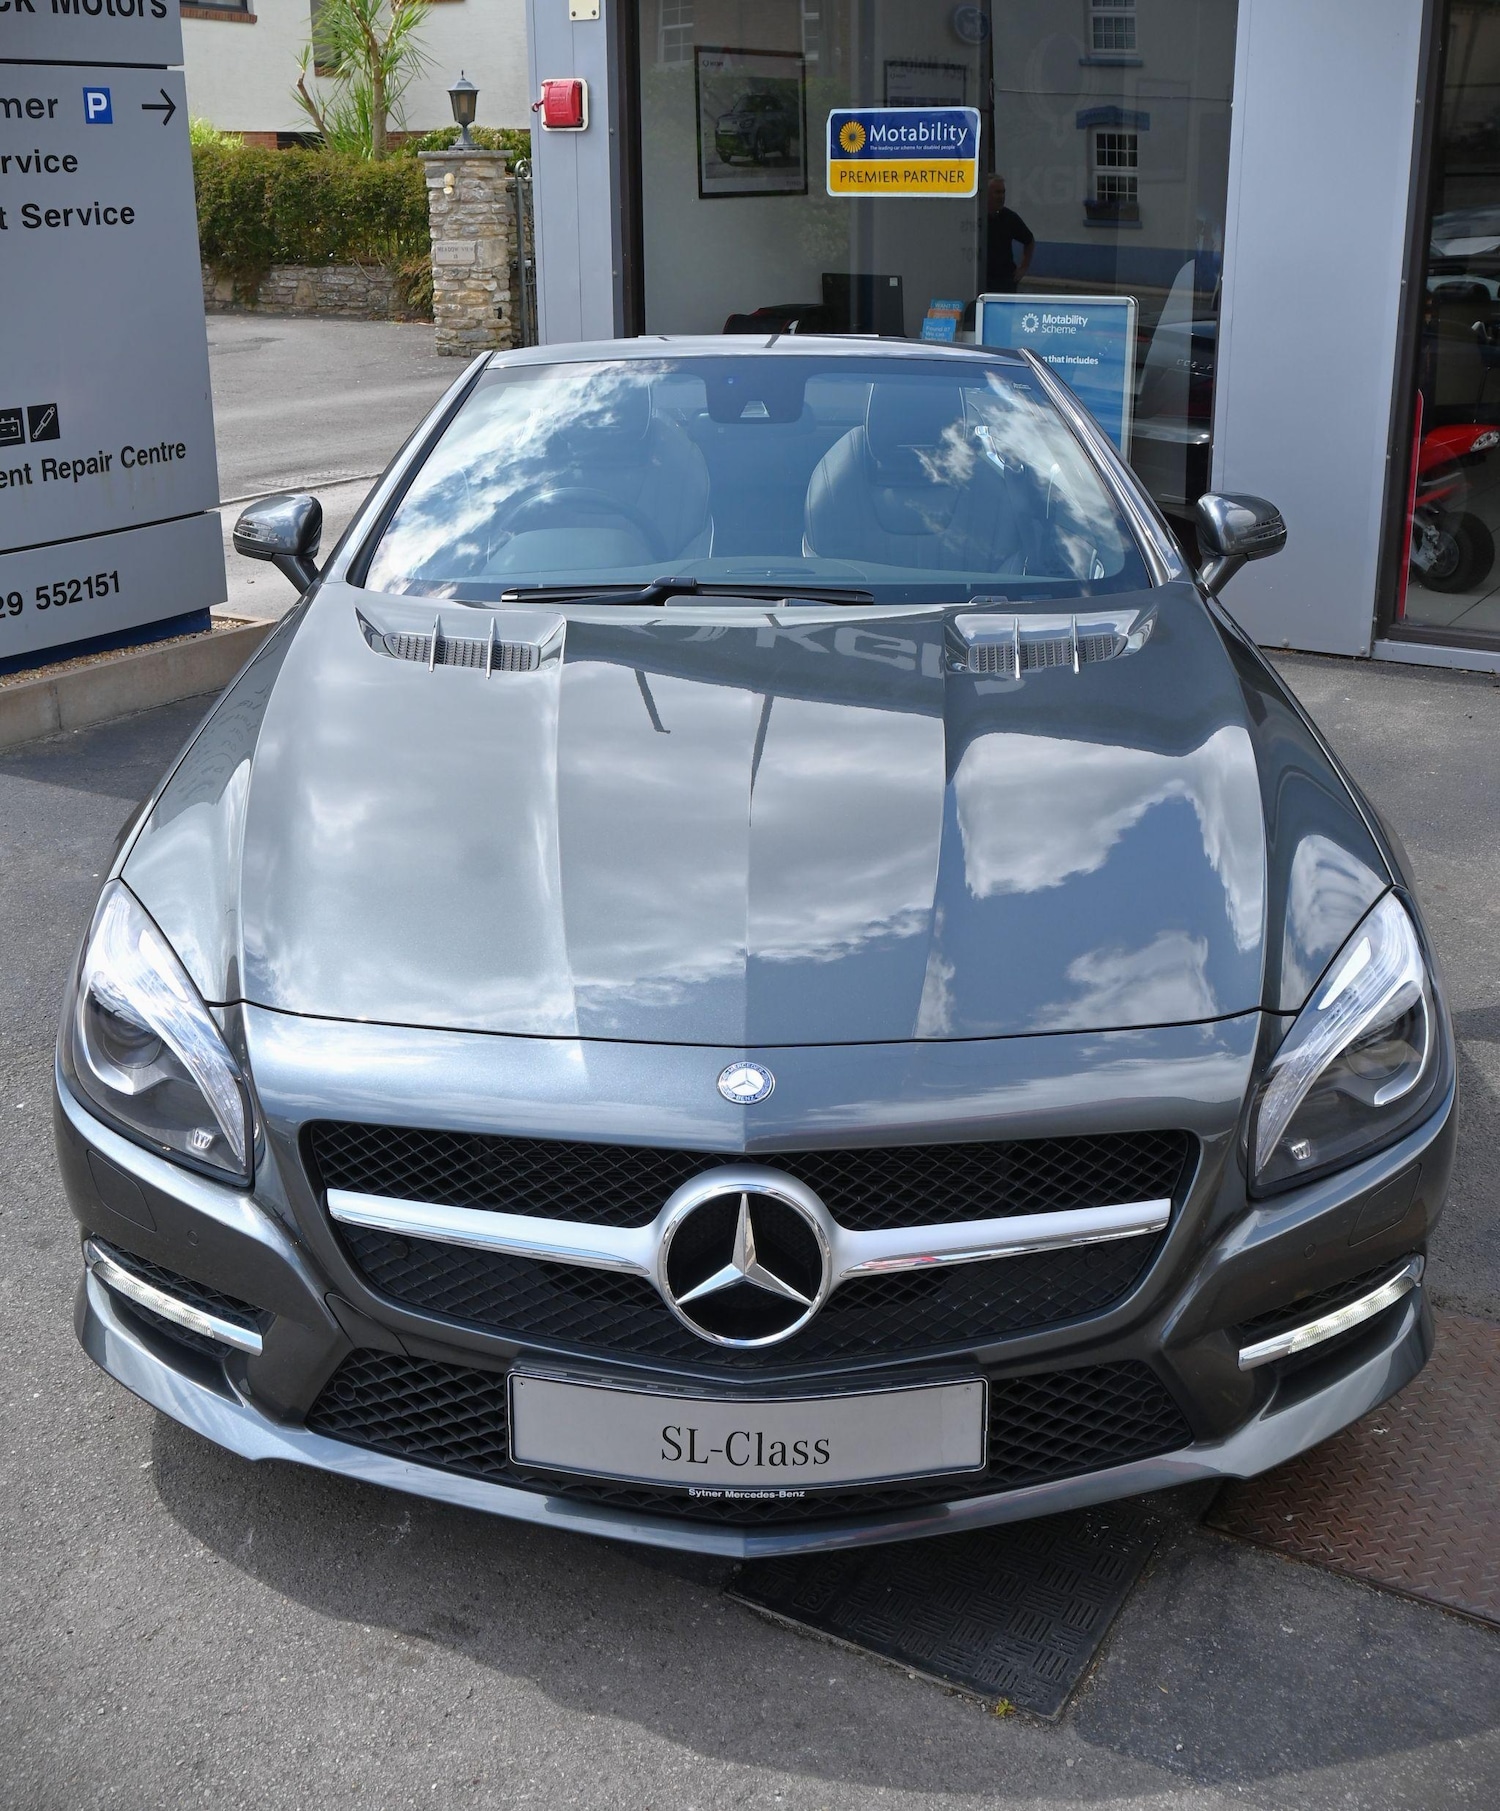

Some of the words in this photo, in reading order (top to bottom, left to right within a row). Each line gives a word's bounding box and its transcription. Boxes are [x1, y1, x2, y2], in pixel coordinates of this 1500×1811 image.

[869, 122, 968, 146] Motability
[1, 150, 78, 174] rvice
[840, 170, 899, 183] PREMIER
[904, 170, 965, 183] PARTNER
[22, 201, 135, 229] Service
[1041, 324, 1077, 334] Scheme
[1042, 314, 1088, 327] Motability
[1048, 355, 1065, 363] that
[1065, 356, 1099, 365] includes
[42, 451, 112, 483] Repair
[120, 441, 187, 469] Centre
[36, 570, 120, 610] 552151
[661, 1425, 831, 1468] SL-Class
[688, 1488, 724, 1499] Sytner
[725, 1489, 806, 1499] Mercedes-Benz
